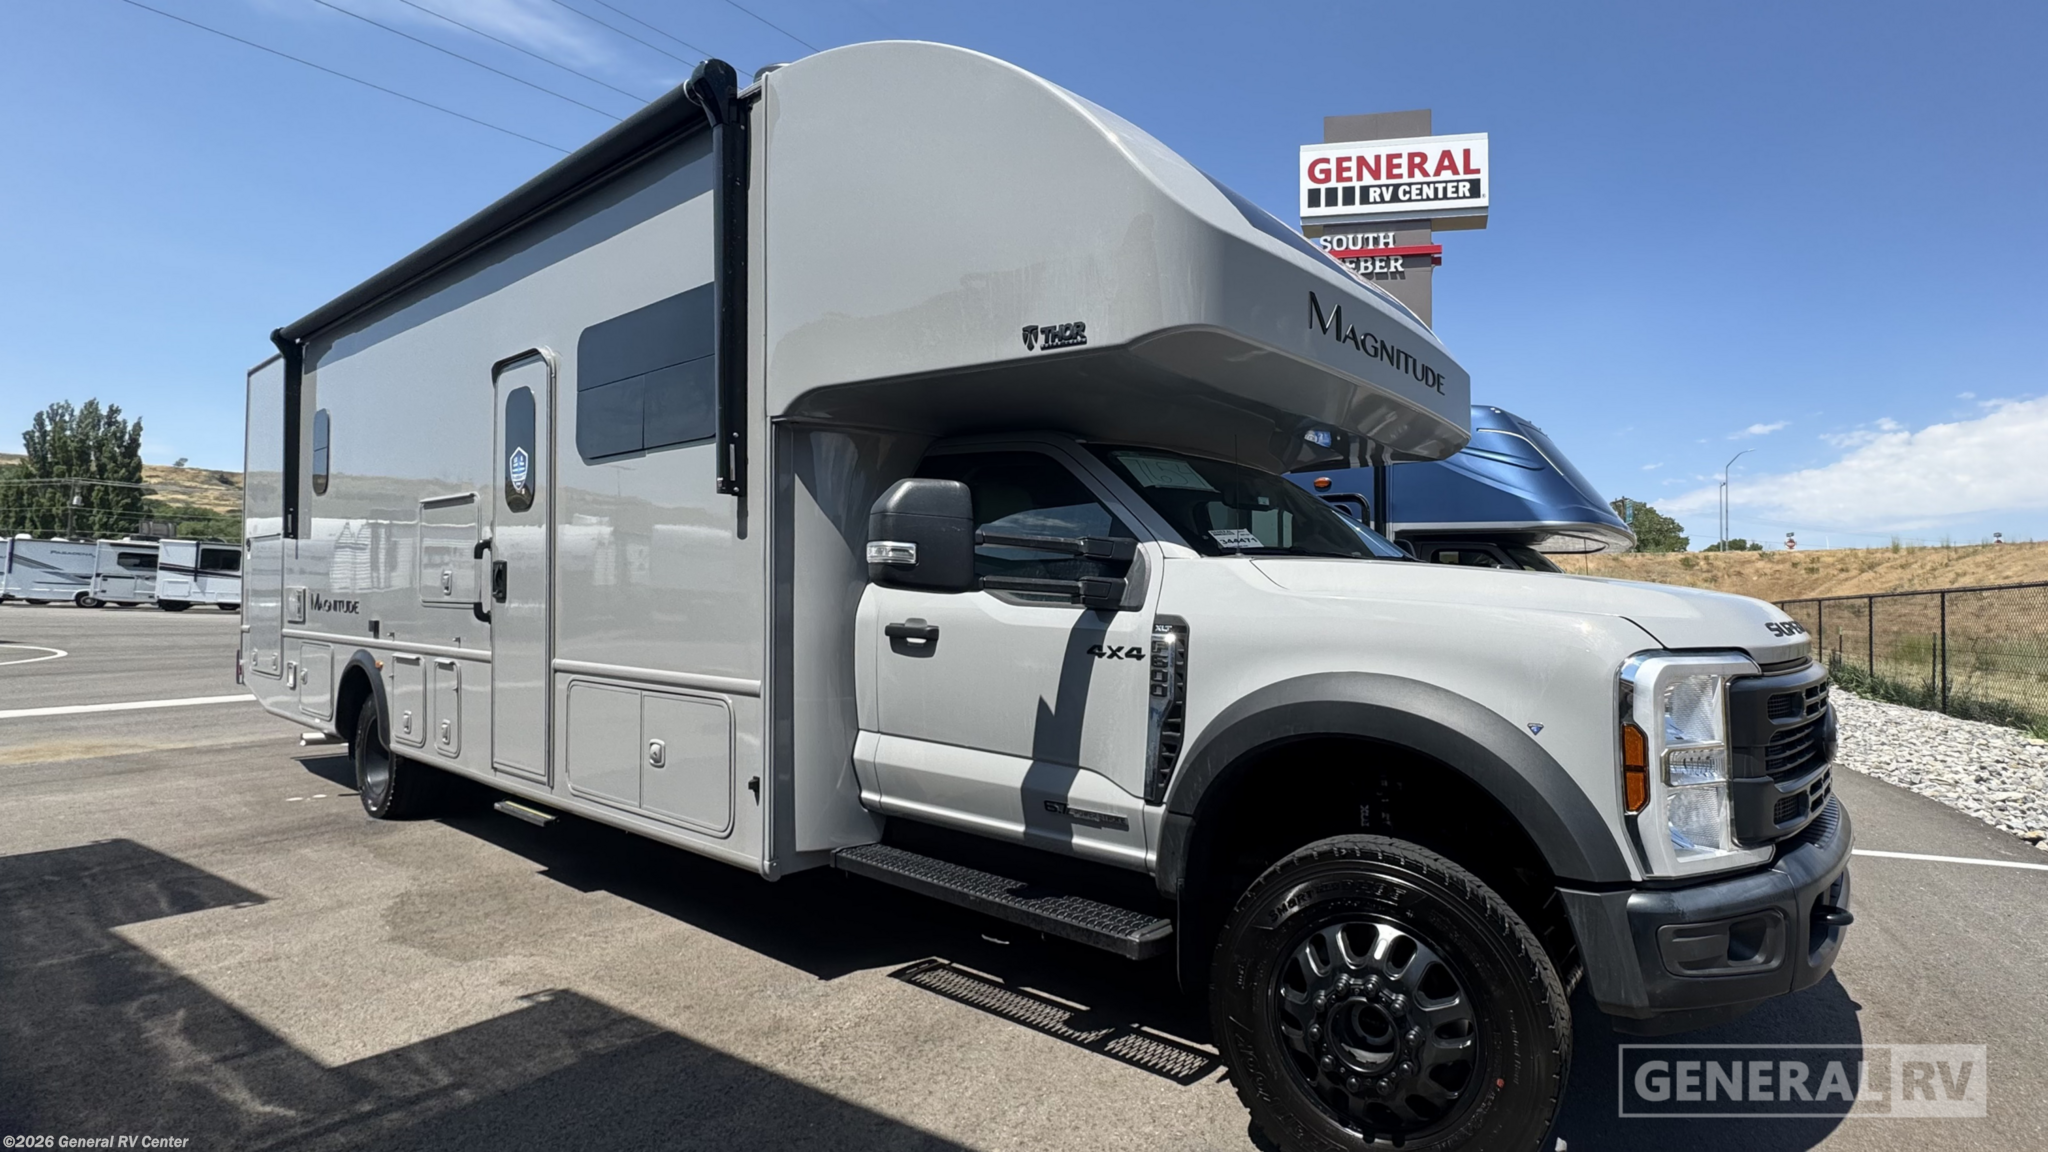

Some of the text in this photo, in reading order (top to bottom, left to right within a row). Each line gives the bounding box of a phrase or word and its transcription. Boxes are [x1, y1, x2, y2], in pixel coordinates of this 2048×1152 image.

[1307, 148, 1481, 184] GENERAL
[1368, 181, 1471, 203] RV CENTER
[1319, 232, 1396, 252] SOUTH
[1342, 255, 1404, 275] EBER
[1040, 321, 1087, 344] THOR
[1308, 290, 1446, 396] MAGNITUDE
[310, 593, 360, 614] MAGNITUDE
[1155, 624, 1173, 632] XLT
